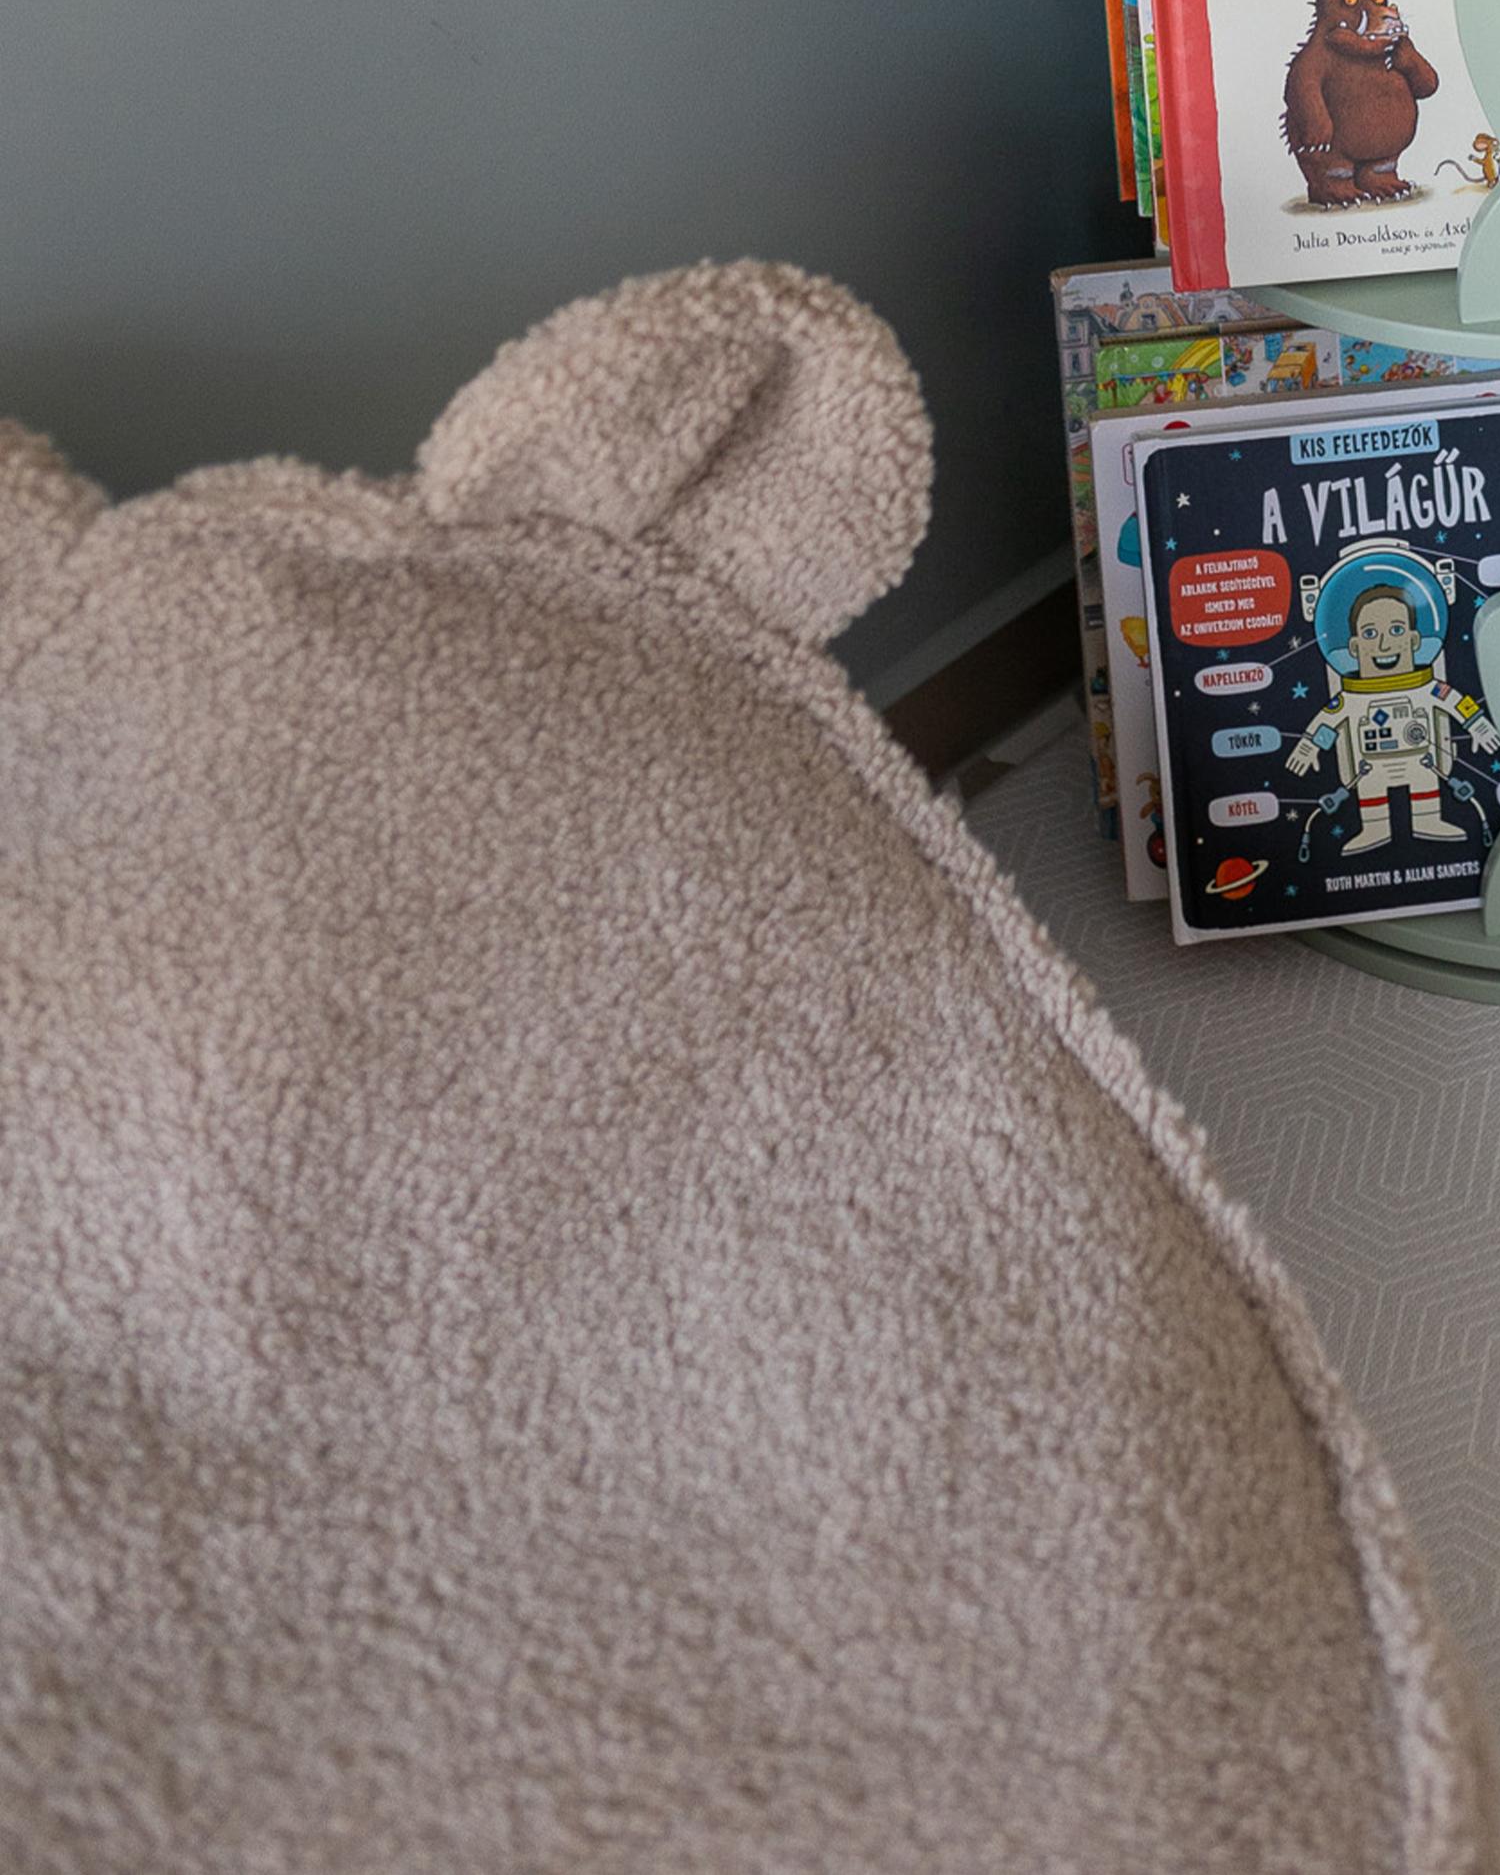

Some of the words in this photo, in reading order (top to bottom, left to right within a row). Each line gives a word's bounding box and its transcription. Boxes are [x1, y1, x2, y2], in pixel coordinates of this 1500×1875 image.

[1294, 232, 1330, 252] Julia
[1336, 225, 1418, 246] Donaldson
[1440, 217, 1471, 237] Axel
[1300, 439, 1325, 459] KIS
[1333, 423, 1433, 455] FELFEDEZŐK
[1262, 487, 1288, 545] A
[1302, 447, 1491, 546] VILÁGŰR
[1196, 564, 1202, 575] A
[1238, 597, 1255, 610] MEG
[1181, 623, 1192, 636] AZ
[1228, 801, 1260, 817] KÖTÉL
[1325, 877, 1352, 892] RUTH
[1354, 872, 1391, 889] MARTIN
[1393, 869, 1402, 884] &
[1405, 865, 1434, 883] ALLAN
[1436, 861, 1480, 878] SANDERS
